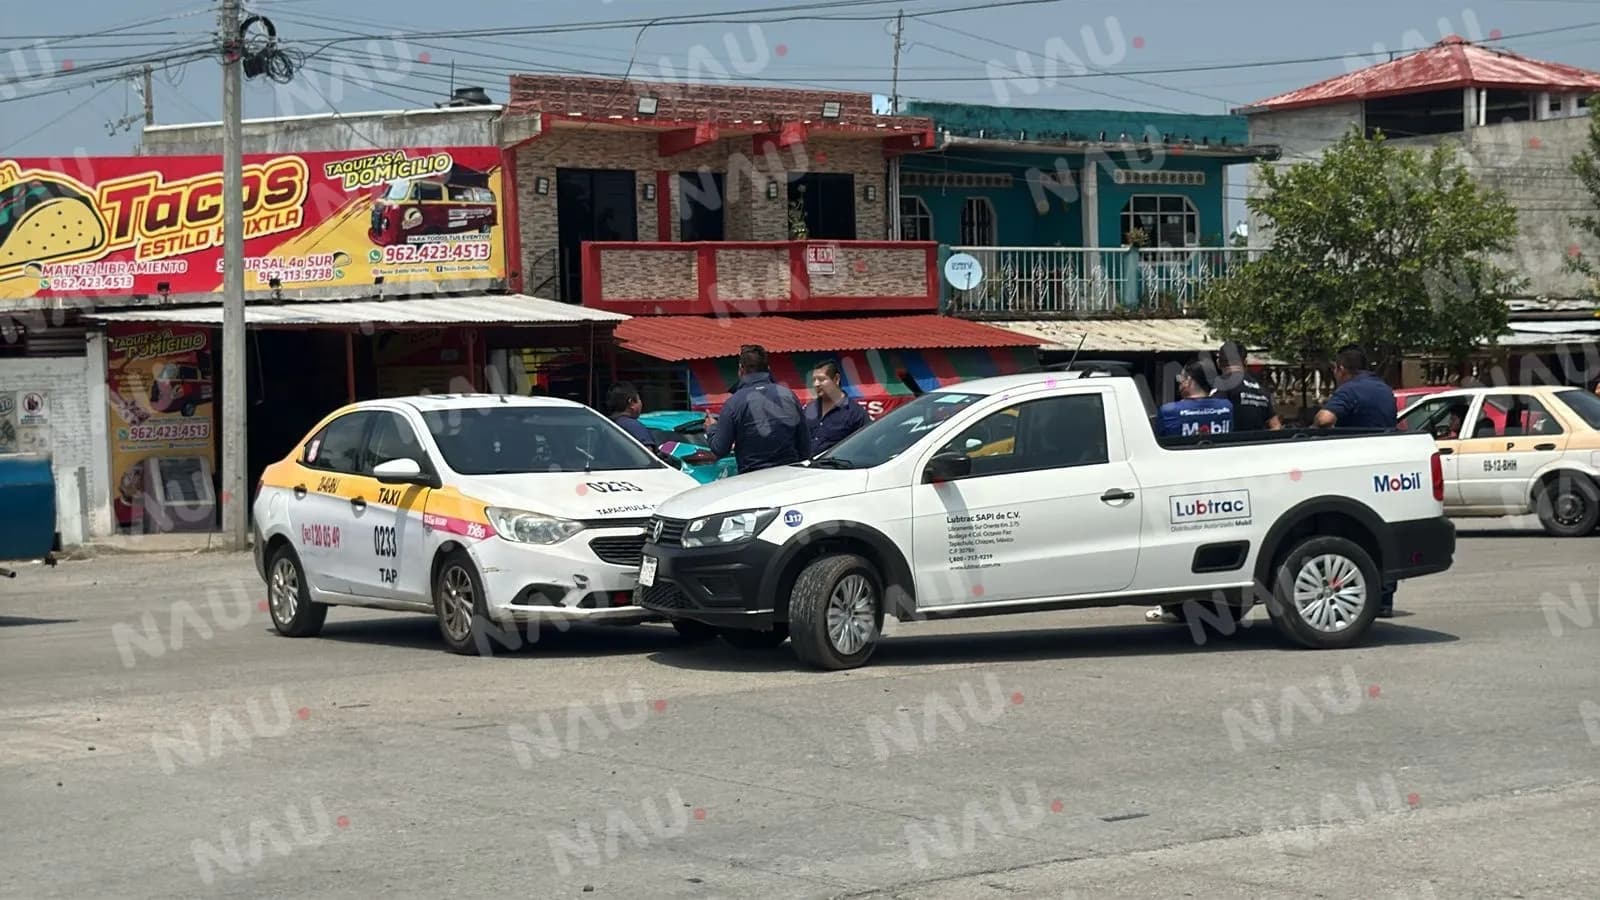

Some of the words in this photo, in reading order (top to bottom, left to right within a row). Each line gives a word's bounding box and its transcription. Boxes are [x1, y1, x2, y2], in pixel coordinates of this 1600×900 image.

[325, 154, 393, 176] TAQUIZAS
[393, 152, 406, 163] A
[344, 155, 451, 188] DOMICILIO
[107, 166, 300, 238] Tacs
[139, 229, 209, 258] ESTILO
[215, 210, 299, 243] HIXTLA
[307, 254, 333, 267] SUR
[386, 243, 489, 262] 962.423.4513
[43, 263, 93, 277] MATRIZ
[99, 261, 187, 275] LIBRAMIENTO
[259, 268, 333, 283] 962.113.9738
[53, 277, 133, 289] 962.423.4513
[1182, 420, 1229, 437] Mobil
[1506, 442, 1515, 450] P
[586, 480, 644, 493] 0233
[1374, 471, 1420, 493] Mobil
[378, 487, 401, 506] TAXI
[1175, 500, 1244, 517] Lubtrac
[946, 515, 975, 524] Lubtrac
[975, 513, 994, 521] SAPI
[995, 512, 1006, 520] de
[1006, 511, 1021, 519] C.V.
[374, 525, 398, 558] 0233
[379, 568, 398, 584] TAP
